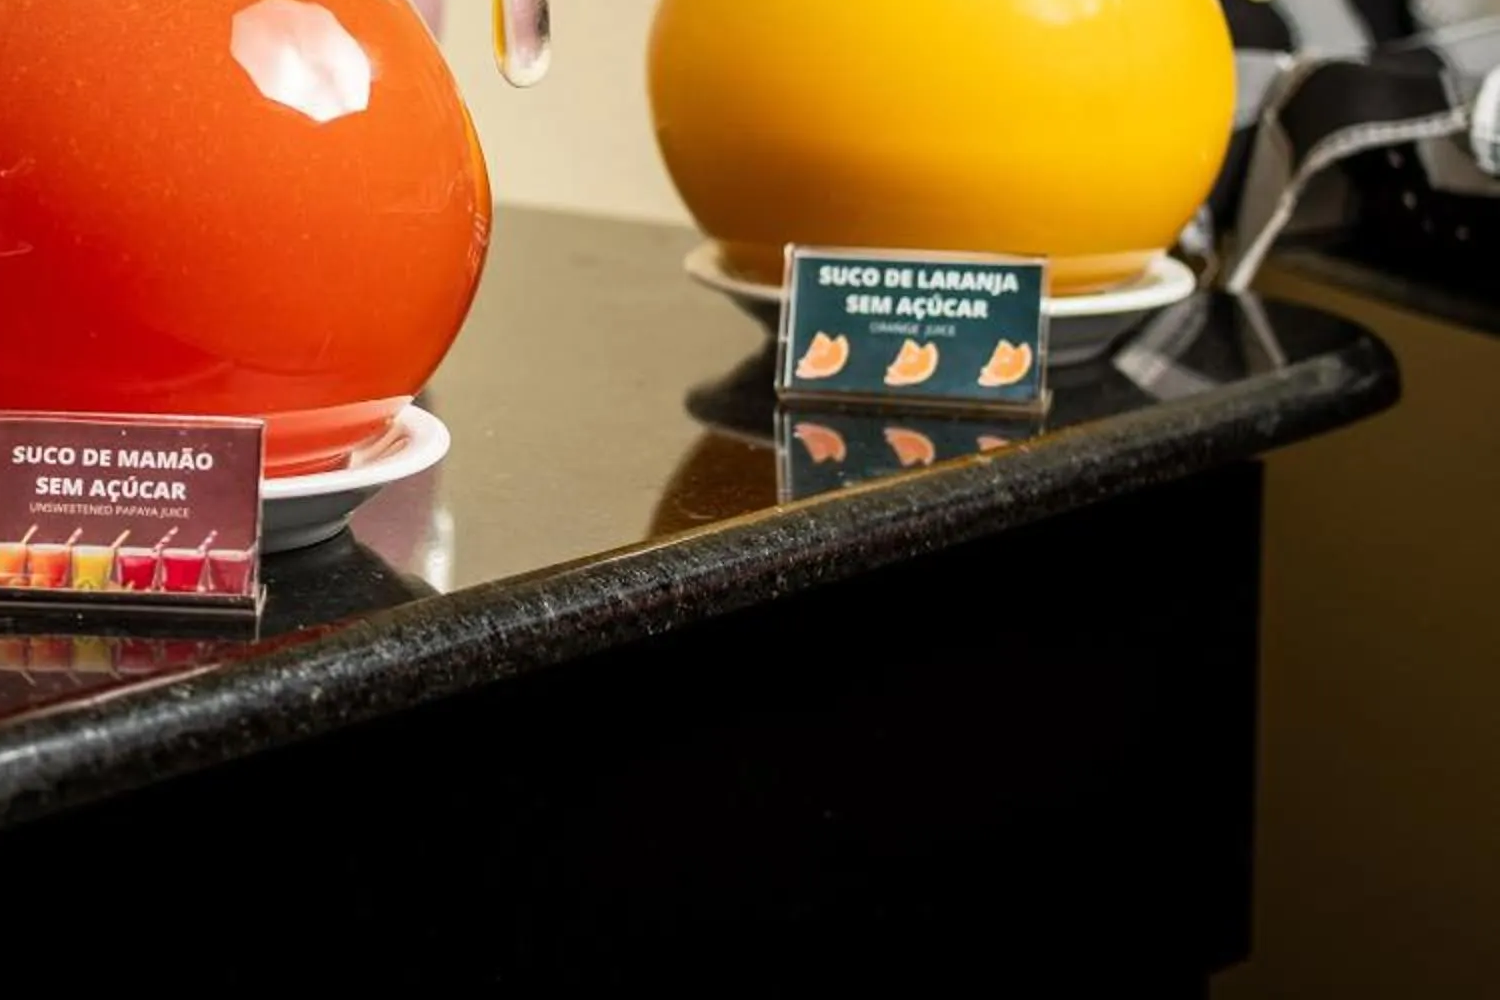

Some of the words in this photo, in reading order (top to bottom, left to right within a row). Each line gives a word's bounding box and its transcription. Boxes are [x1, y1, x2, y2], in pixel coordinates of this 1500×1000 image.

[819, 266, 879, 286] SUCO
[884, 269, 913, 288] DE
[917, 270, 1019, 295] LARANJA
[846, 295, 891, 314] SEM
[896, 294, 988, 319] AÇÚCAR
[12, 446, 75, 464] SUCO
[83, 448, 111, 467] DE
[117, 448, 214, 470] MAMÃO
[35, 477, 83, 496] SEM
[89, 476, 187, 502] AÇÚCAR
[29, 503, 112, 516] UNSWEETENED
[115, 505, 158, 517] PAPAYA
